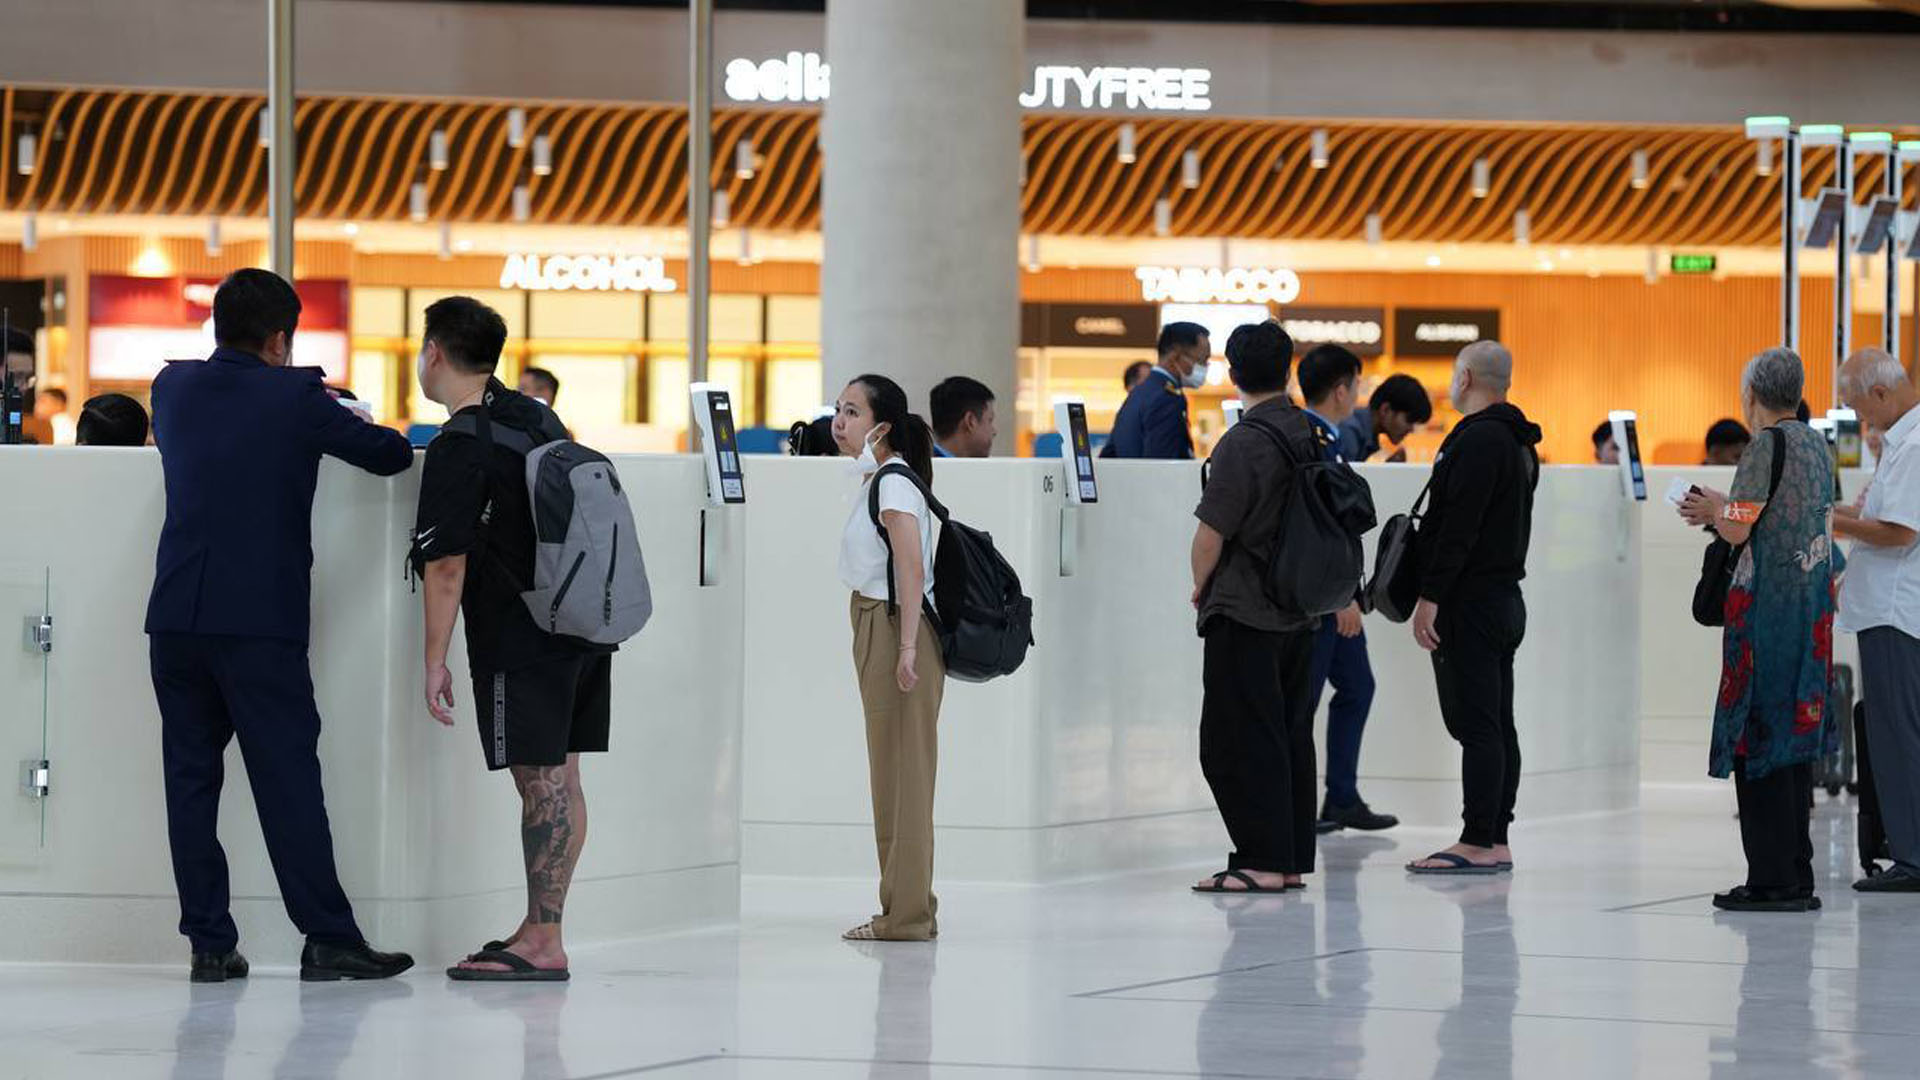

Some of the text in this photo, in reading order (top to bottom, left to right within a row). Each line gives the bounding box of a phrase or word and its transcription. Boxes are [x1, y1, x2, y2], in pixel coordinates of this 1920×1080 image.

[1018, 66, 1211, 109] UTYFREE
[500, 253, 677, 292] ALCOHOL
[1043, 475, 1054, 493] 06
